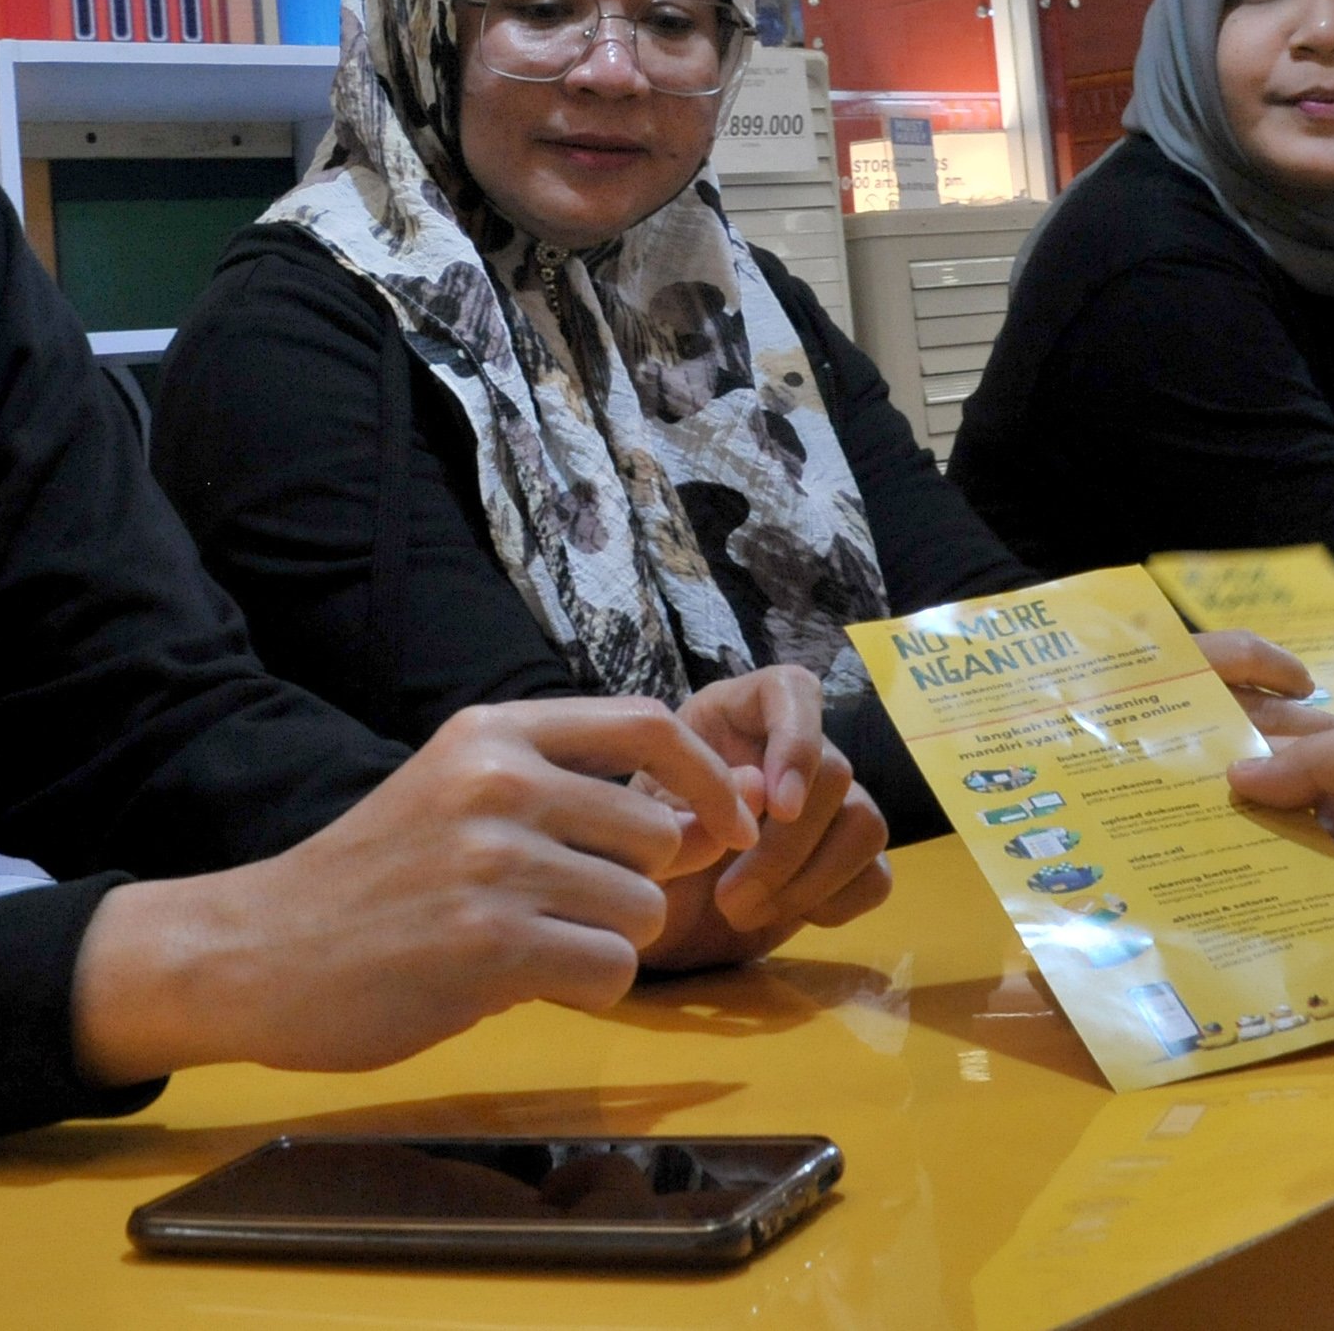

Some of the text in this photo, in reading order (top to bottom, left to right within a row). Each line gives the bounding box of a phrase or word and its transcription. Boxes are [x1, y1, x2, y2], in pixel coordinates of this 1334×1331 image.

[723, 114, 805, 137] .899.000
[853, 159, 893, 173] STOR
[891, 599, 1058, 661] NO MORE
[909, 630, 1081, 692] NGANTRI!
[958, 741, 1022, 761] mandiri
[1096, 713, 1138, 729] ecara
[1140, 698, 1192, 721] online
[975, 719, 1042, 744] langkah
[1089, 693, 1160, 719] rekening
